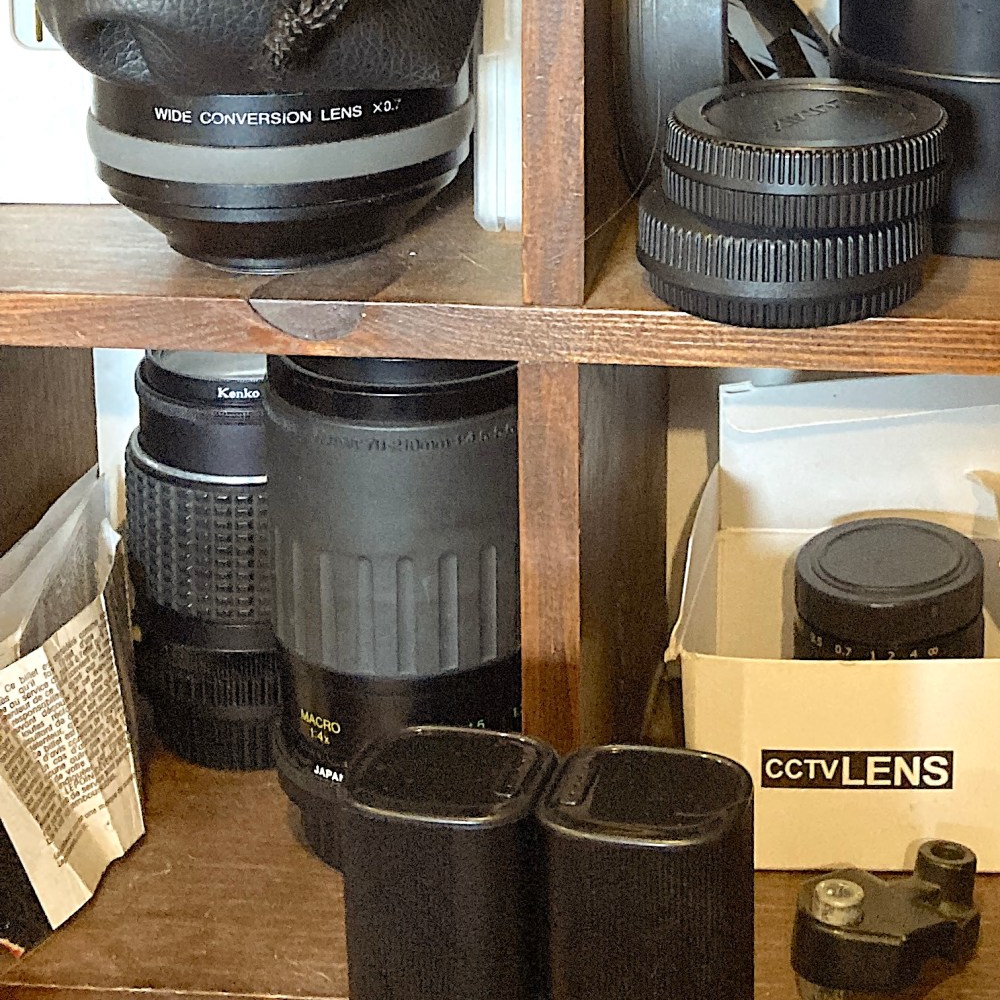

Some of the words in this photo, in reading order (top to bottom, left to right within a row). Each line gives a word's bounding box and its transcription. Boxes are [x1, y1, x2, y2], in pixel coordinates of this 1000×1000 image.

[154, 107, 192, 124] WIDE
[199, 110, 312, 125] CONVERSION
[320, 105, 363, 122] LENS
[217, 386, 261, 399] Kenko
[300, 708, 341, 734] MACRO
